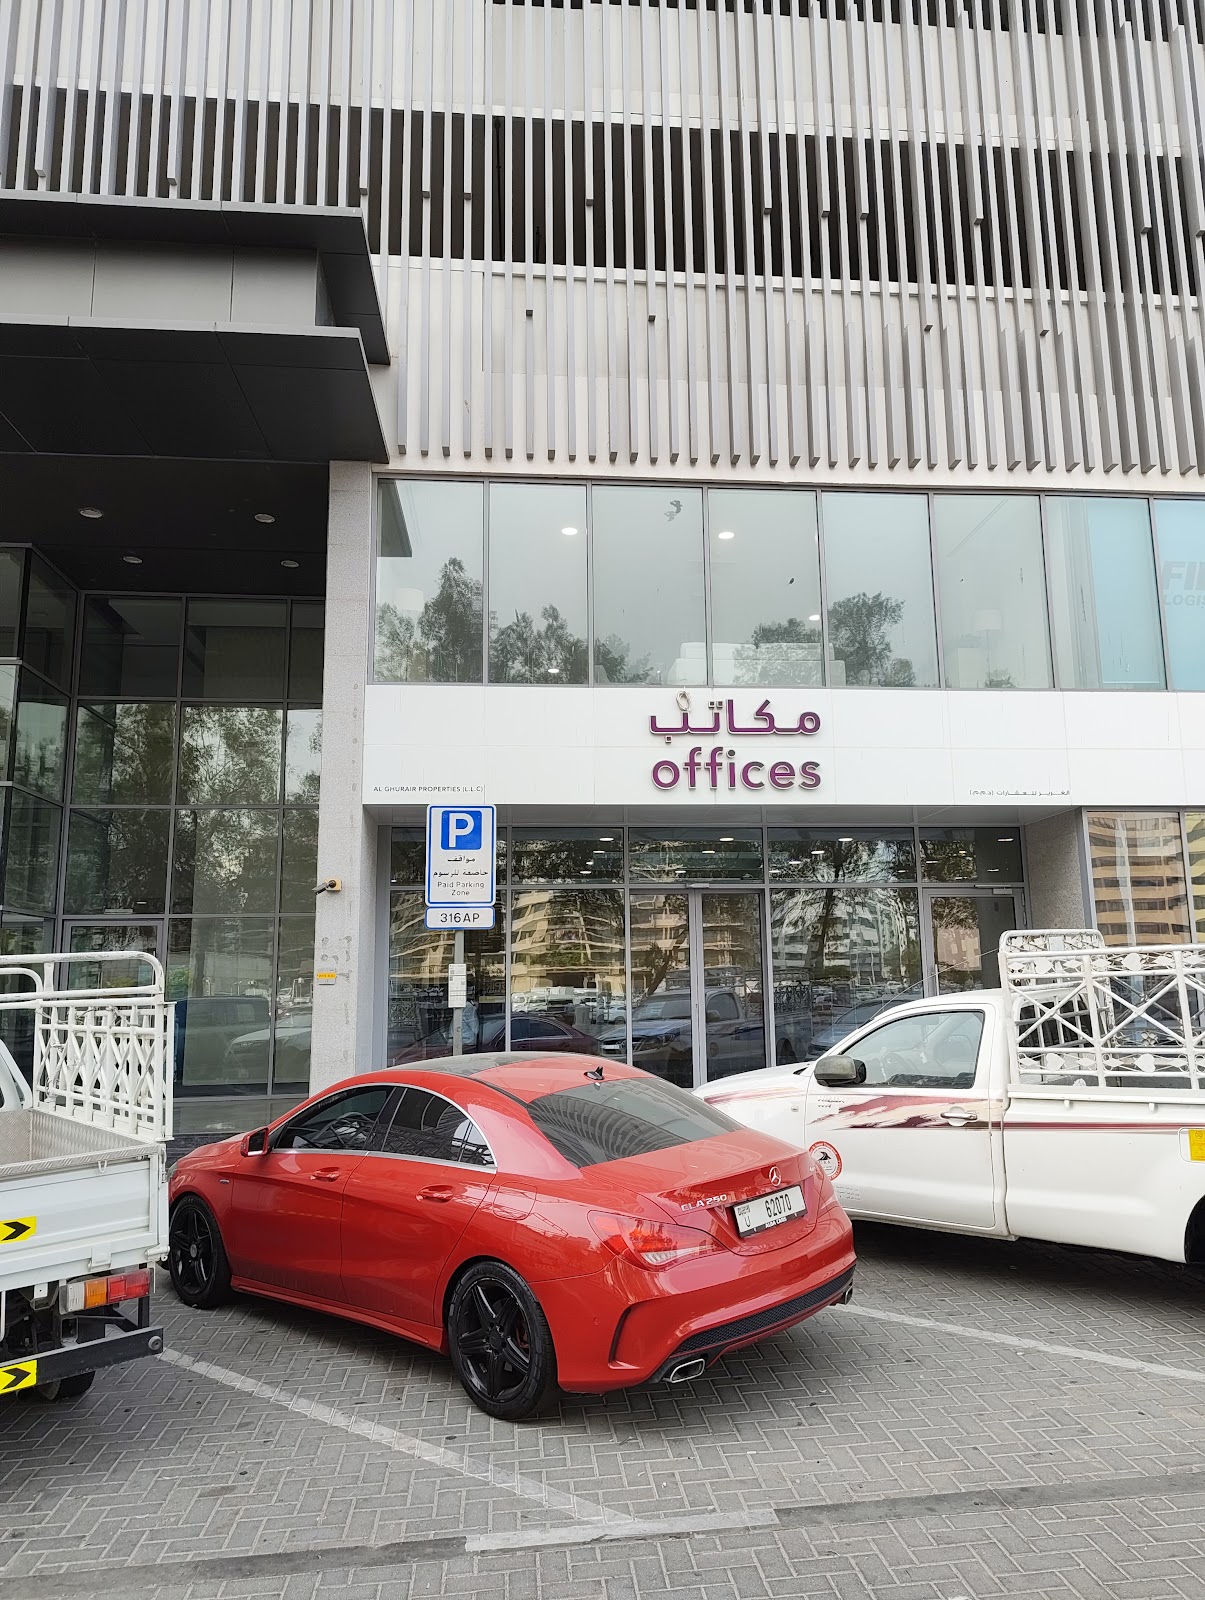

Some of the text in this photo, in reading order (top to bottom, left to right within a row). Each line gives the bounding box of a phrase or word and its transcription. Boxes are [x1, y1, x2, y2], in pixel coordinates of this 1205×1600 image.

[650, 699, 821, 743] مكاتب
[652, 746, 821, 790] offices
[448, 812, 475, 848] P
[447, 854, 476, 864] مواقف
[456, 881, 485, 889] Parking
[440, 912, 480, 923] 316AP
[705, 1194, 727, 1205] 250
[764, 1193, 792, 1218] 62070
